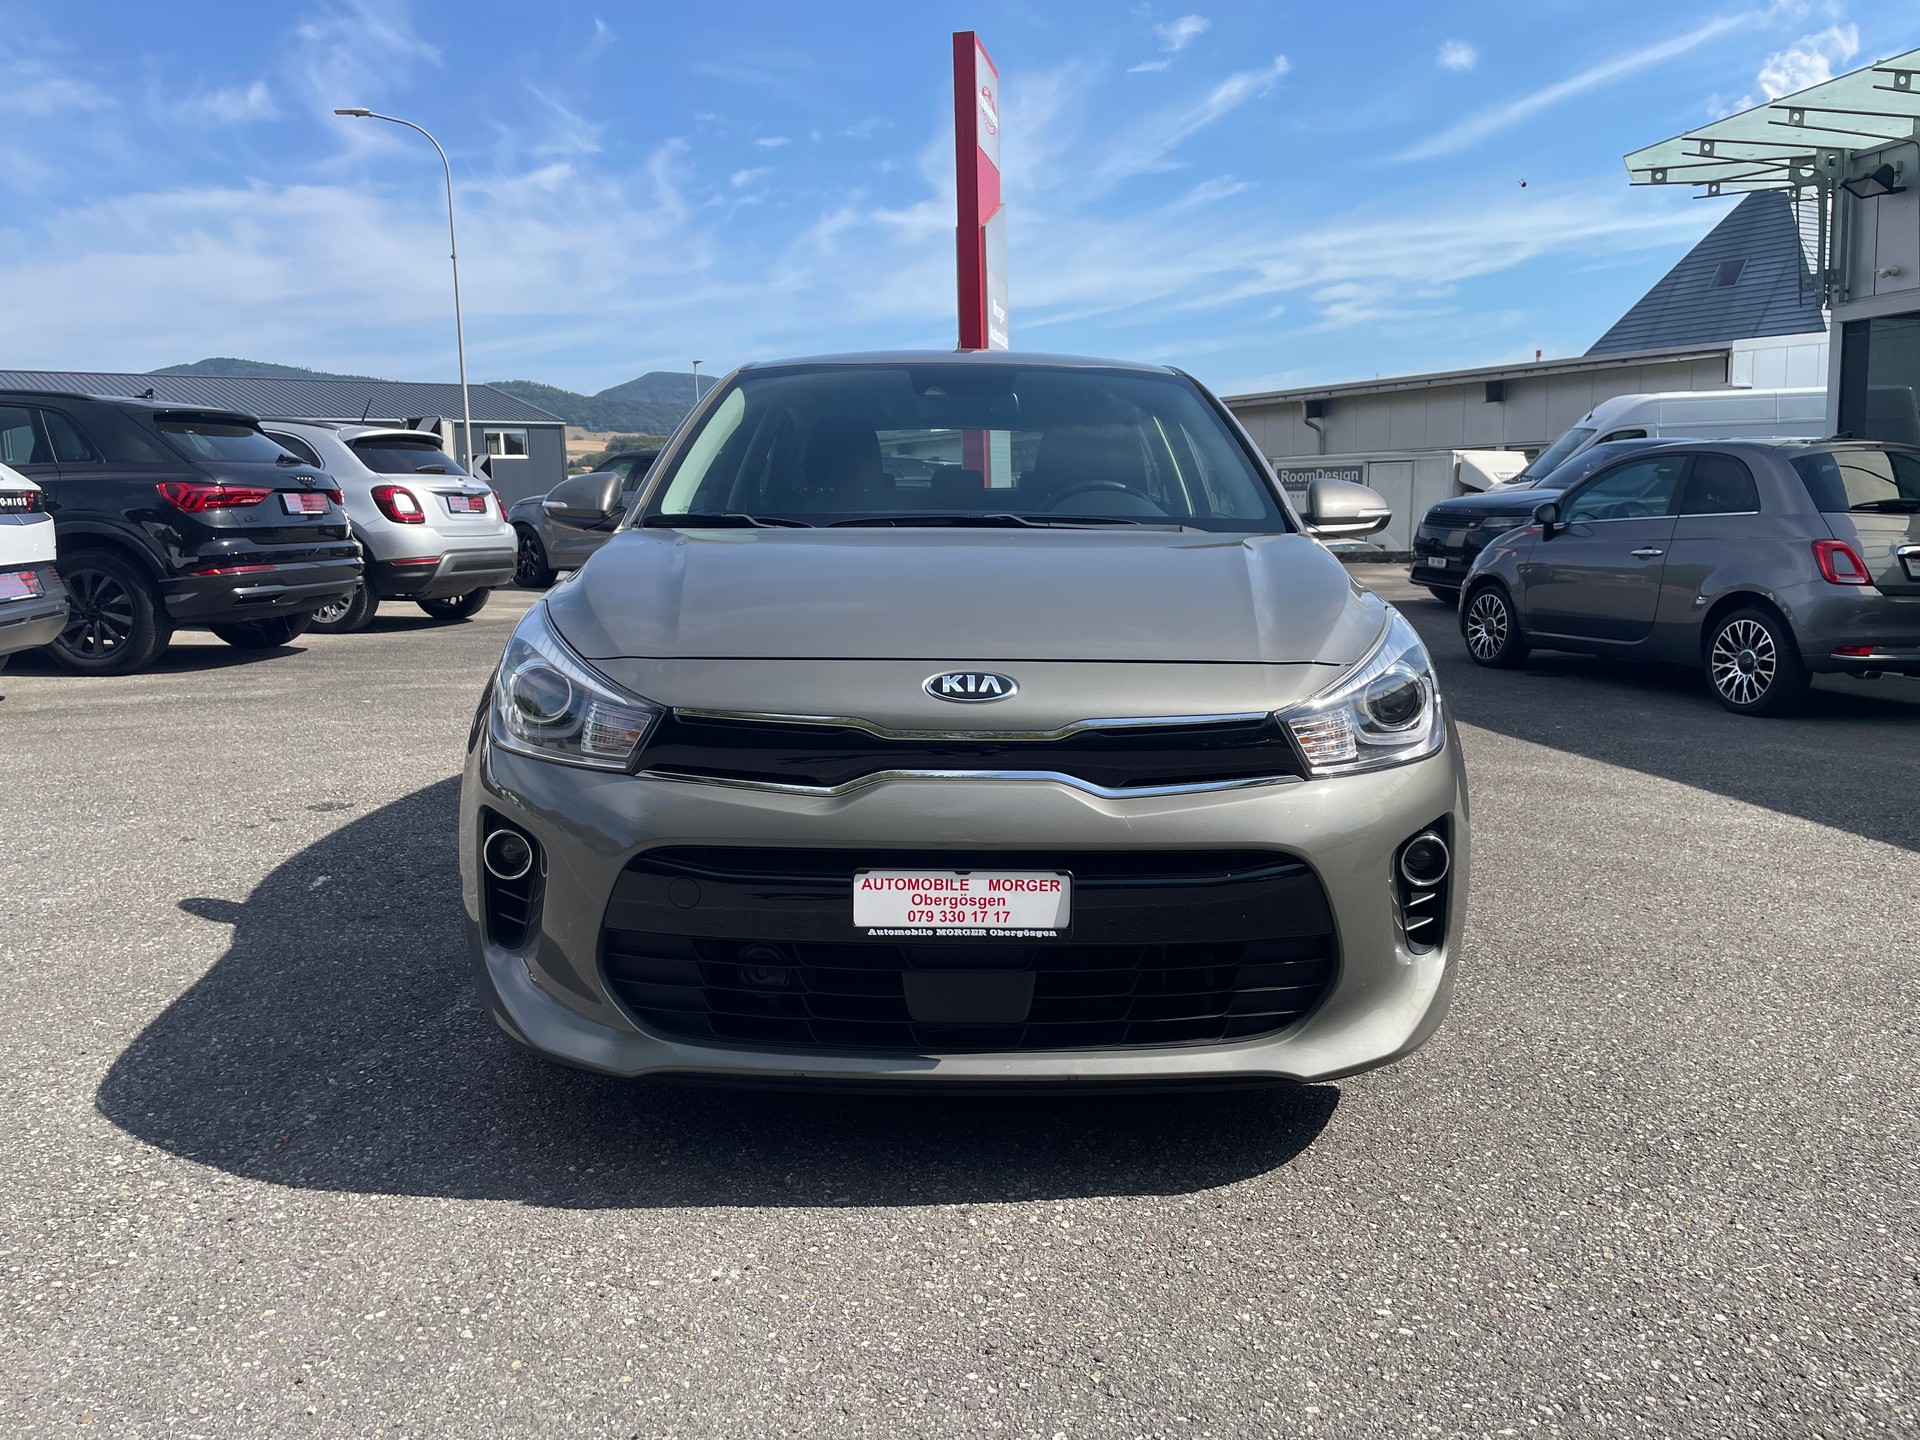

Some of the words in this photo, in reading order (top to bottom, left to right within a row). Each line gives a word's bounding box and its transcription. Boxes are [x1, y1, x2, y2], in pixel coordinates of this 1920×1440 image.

[1280, 469, 1359, 483] RoomDesign
[941, 675, 1003, 693] KIA
[861, 878, 970, 891] AUTOMOBILE
[988, 879, 1061, 892] MORGER
[911, 893, 1006, 909] Obergösgen
[907, 910, 934, 923] 079
[939, 910, 966, 923] 330
[971, 911, 988, 923] 17
[993, 911, 1011, 923] 17
[867, 928, 933, 937] Automobile
[935, 928, 987, 937] MORGER
[989, 928, 1057, 937] Obergösgen
